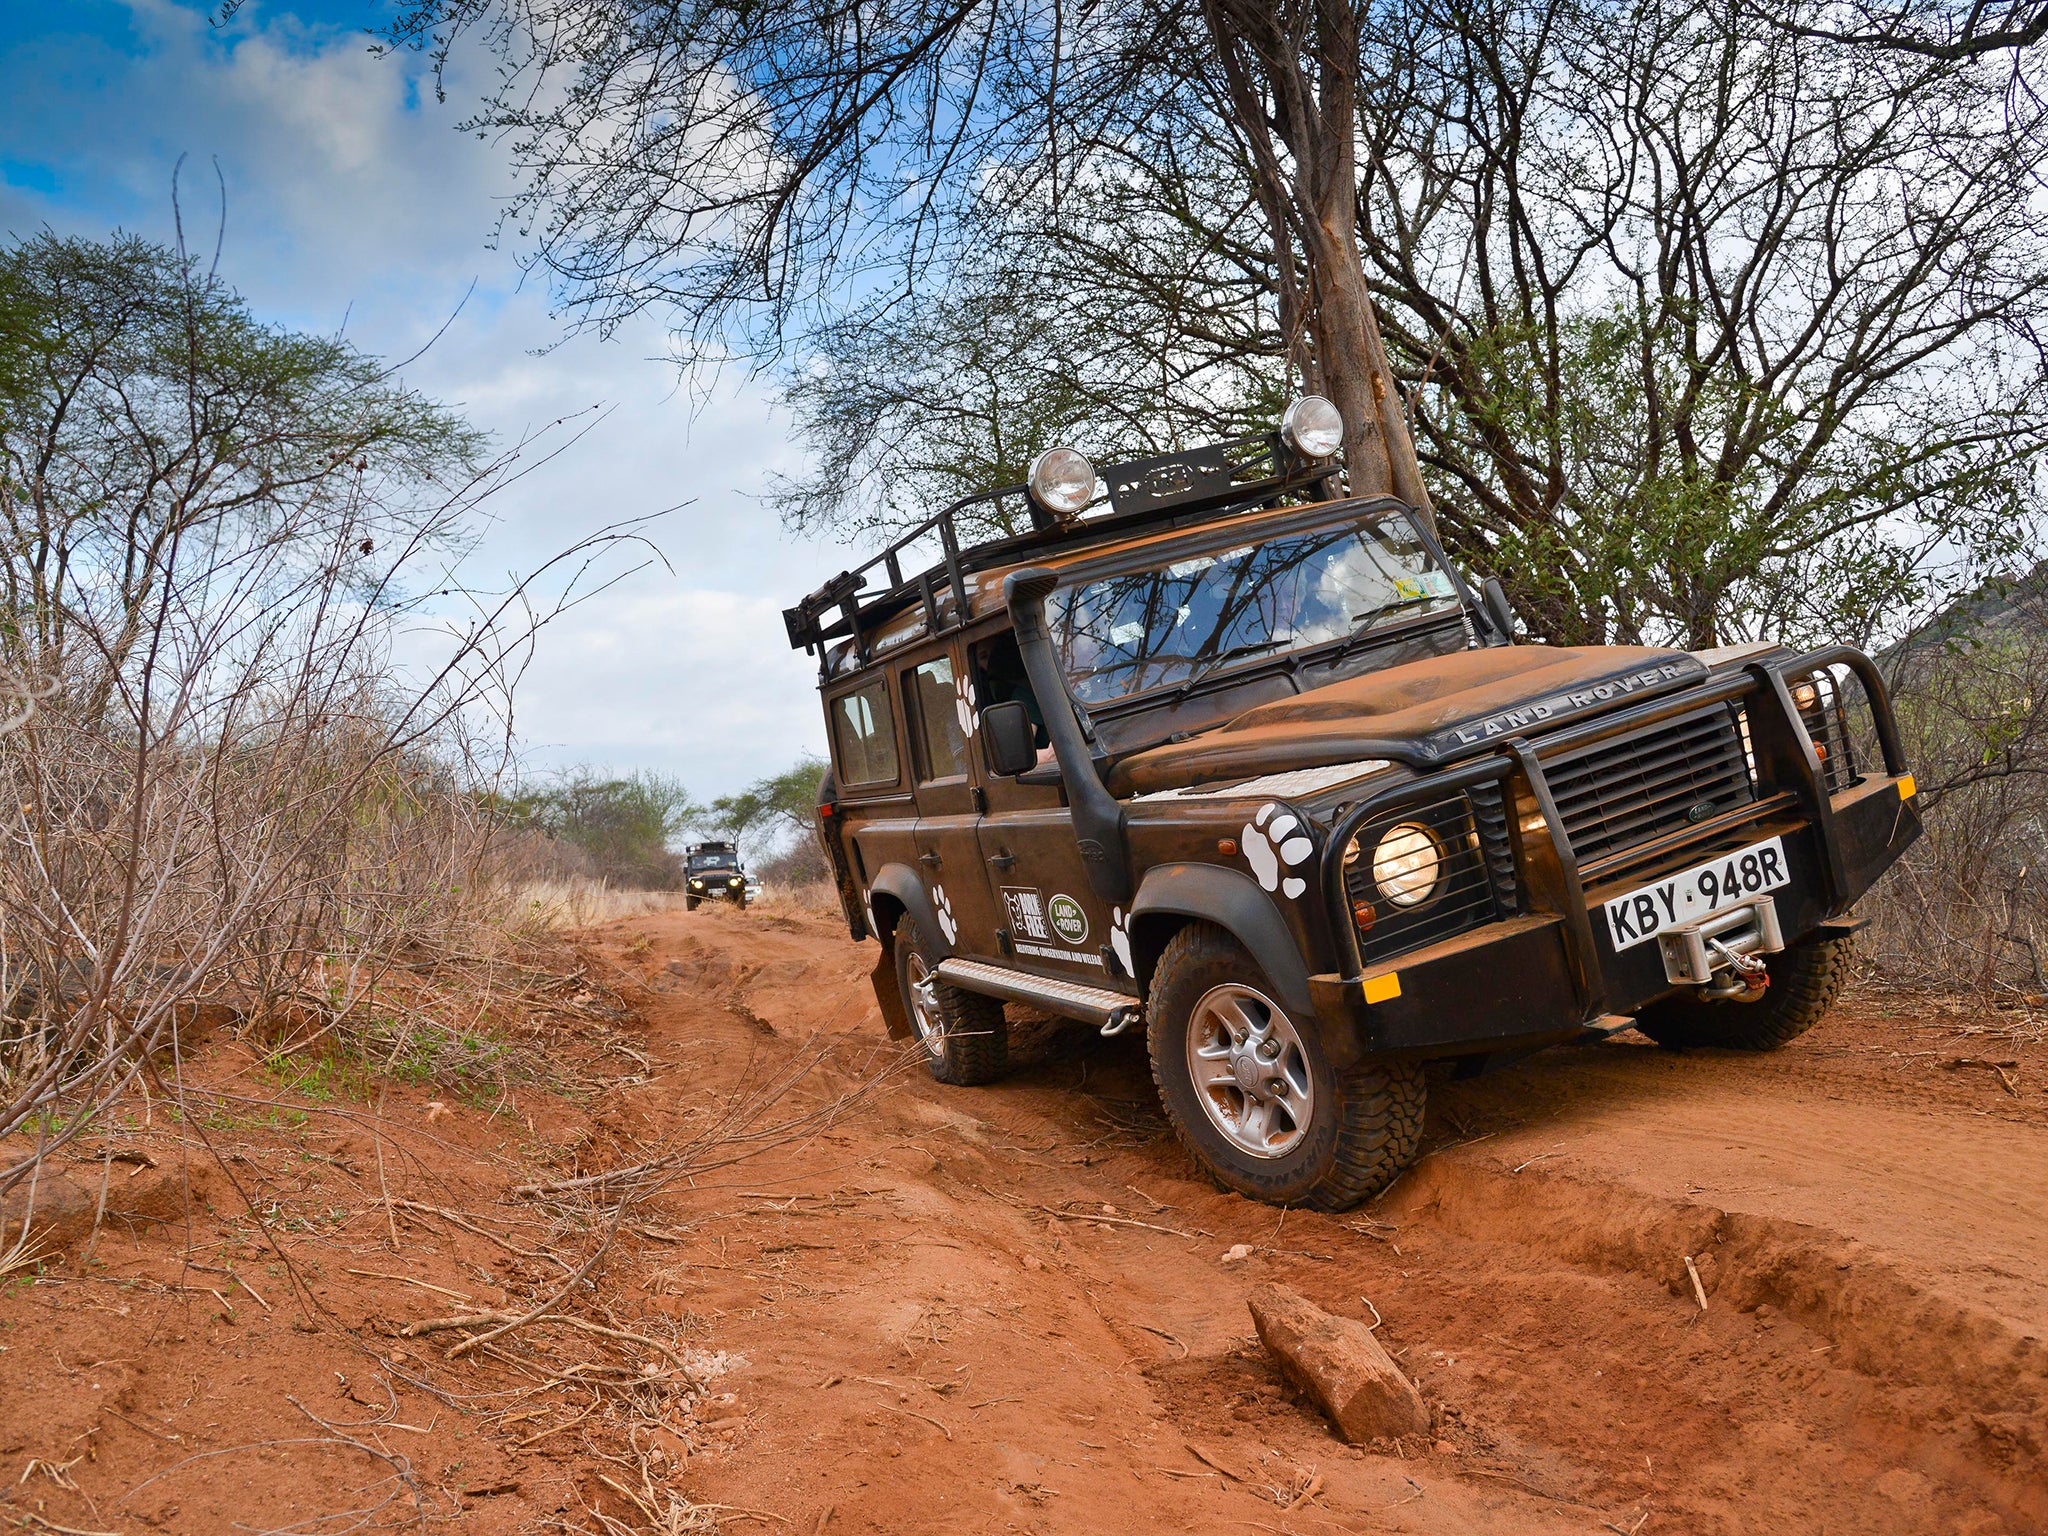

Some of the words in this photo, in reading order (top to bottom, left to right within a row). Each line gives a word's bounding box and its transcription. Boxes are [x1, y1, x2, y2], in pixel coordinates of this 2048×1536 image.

[1454, 706, 1553, 744] LAND
[1567, 664, 1681, 708] ROVER
[1018, 893, 1041, 915] BORN
[1610, 882, 1676, 944] KBY
[1697, 847, 1784, 910] 948R
[1054, 904, 1073, 918] LAND
[1024, 915, 1048, 938] FREE
[1060, 919, 1082, 932] ROVER
